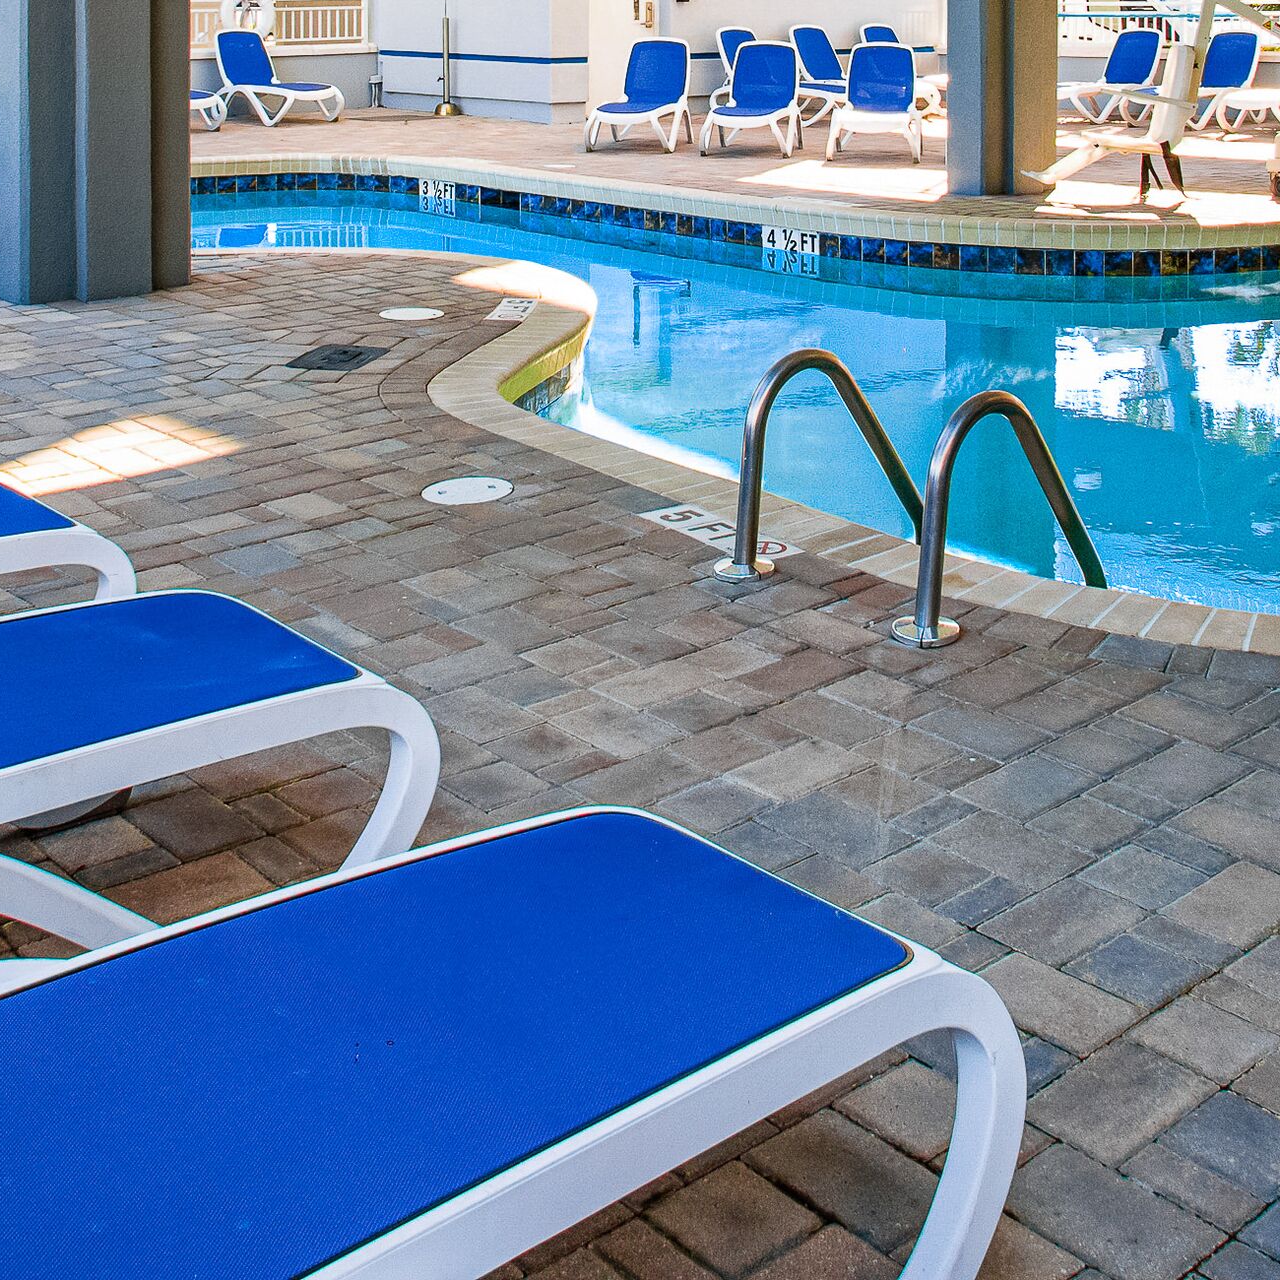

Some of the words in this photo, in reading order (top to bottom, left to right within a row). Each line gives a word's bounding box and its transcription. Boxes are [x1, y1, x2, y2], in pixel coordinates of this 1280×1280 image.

[422, 181, 429, 195] 3
[443, 183, 454, 199] FT
[767, 229, 776, 247] 4
[800, 232, 817, 253] FT
[660, 509, 704, 522] 5
